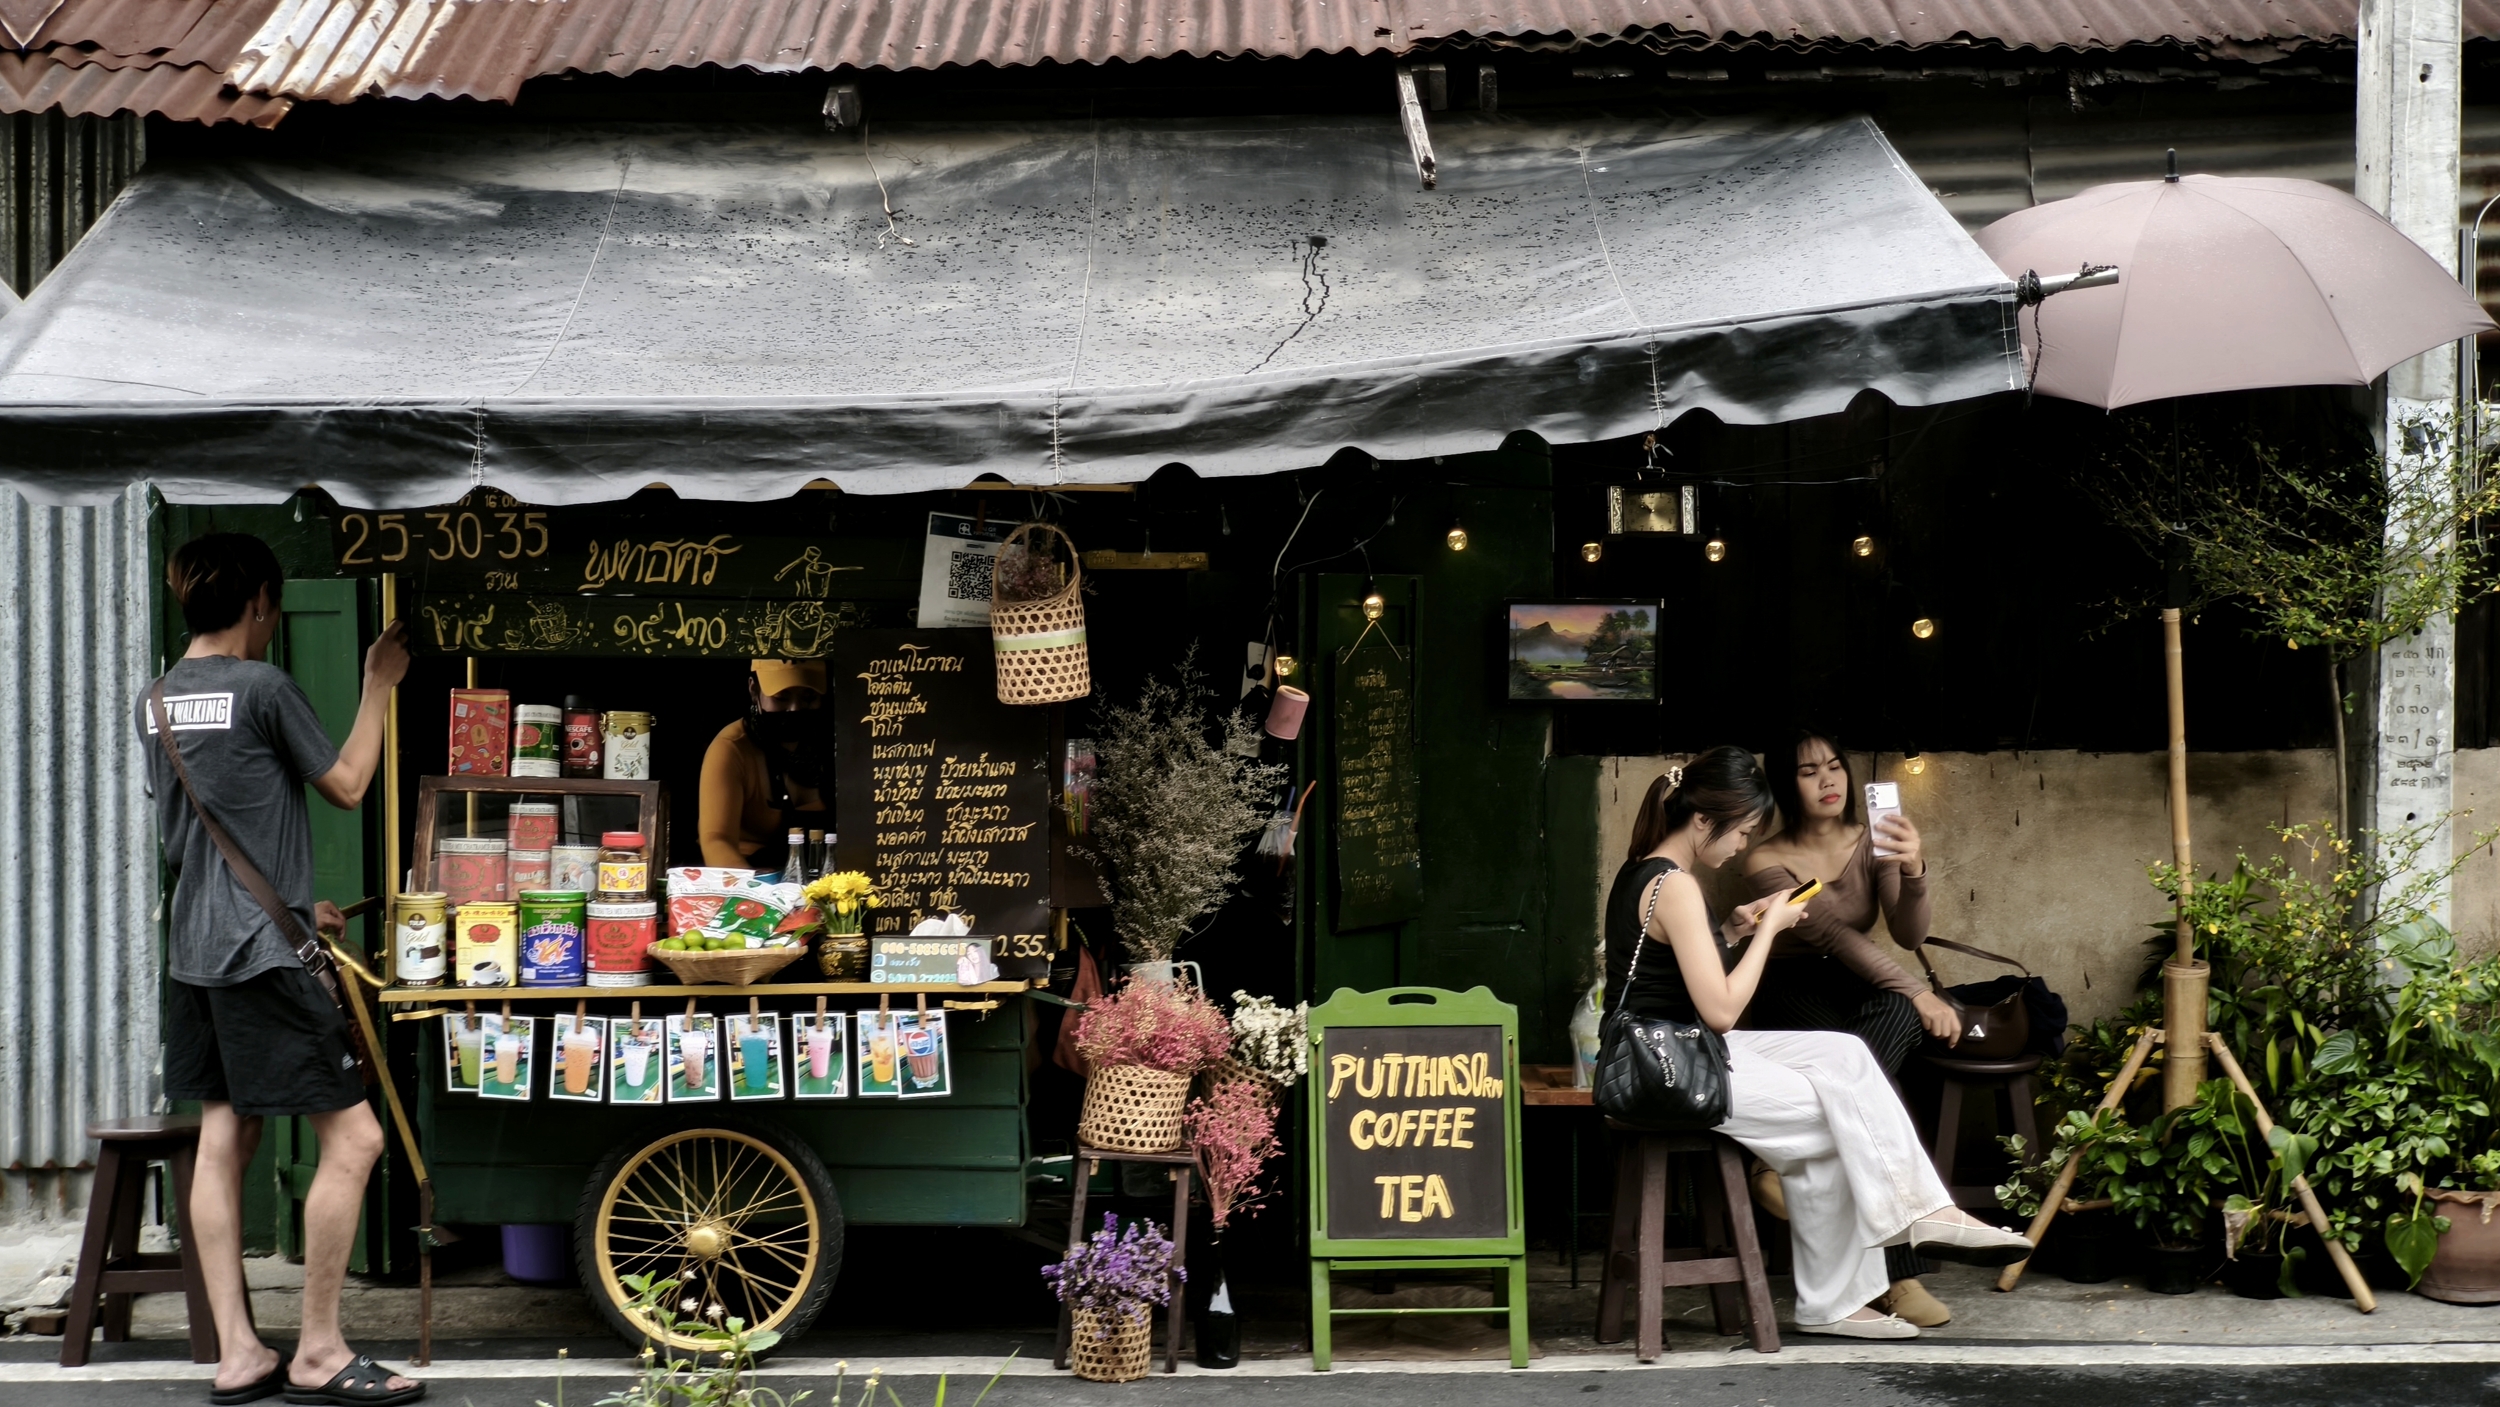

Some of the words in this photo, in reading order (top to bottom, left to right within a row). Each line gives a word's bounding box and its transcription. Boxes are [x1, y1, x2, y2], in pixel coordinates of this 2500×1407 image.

[340, 512, 548, 565] 25-30-35
[869, 643, 965, 674] กาแฟโบราณ
[857, 672, 913, 696] โอวัลติน
[174, 698, 228, 724] WALKING
[860, 714, 906, 738] โกโก้
[872, 738, 936, 760] เนสกาแฟ
[873, 760, 928, 785] นมชมพู
[946, 802, 1011, 823] ชามะนาว
[1349, 1107, 1477, 1150] COFFEE
[1374, 1173, 1455, 1222] TEA
